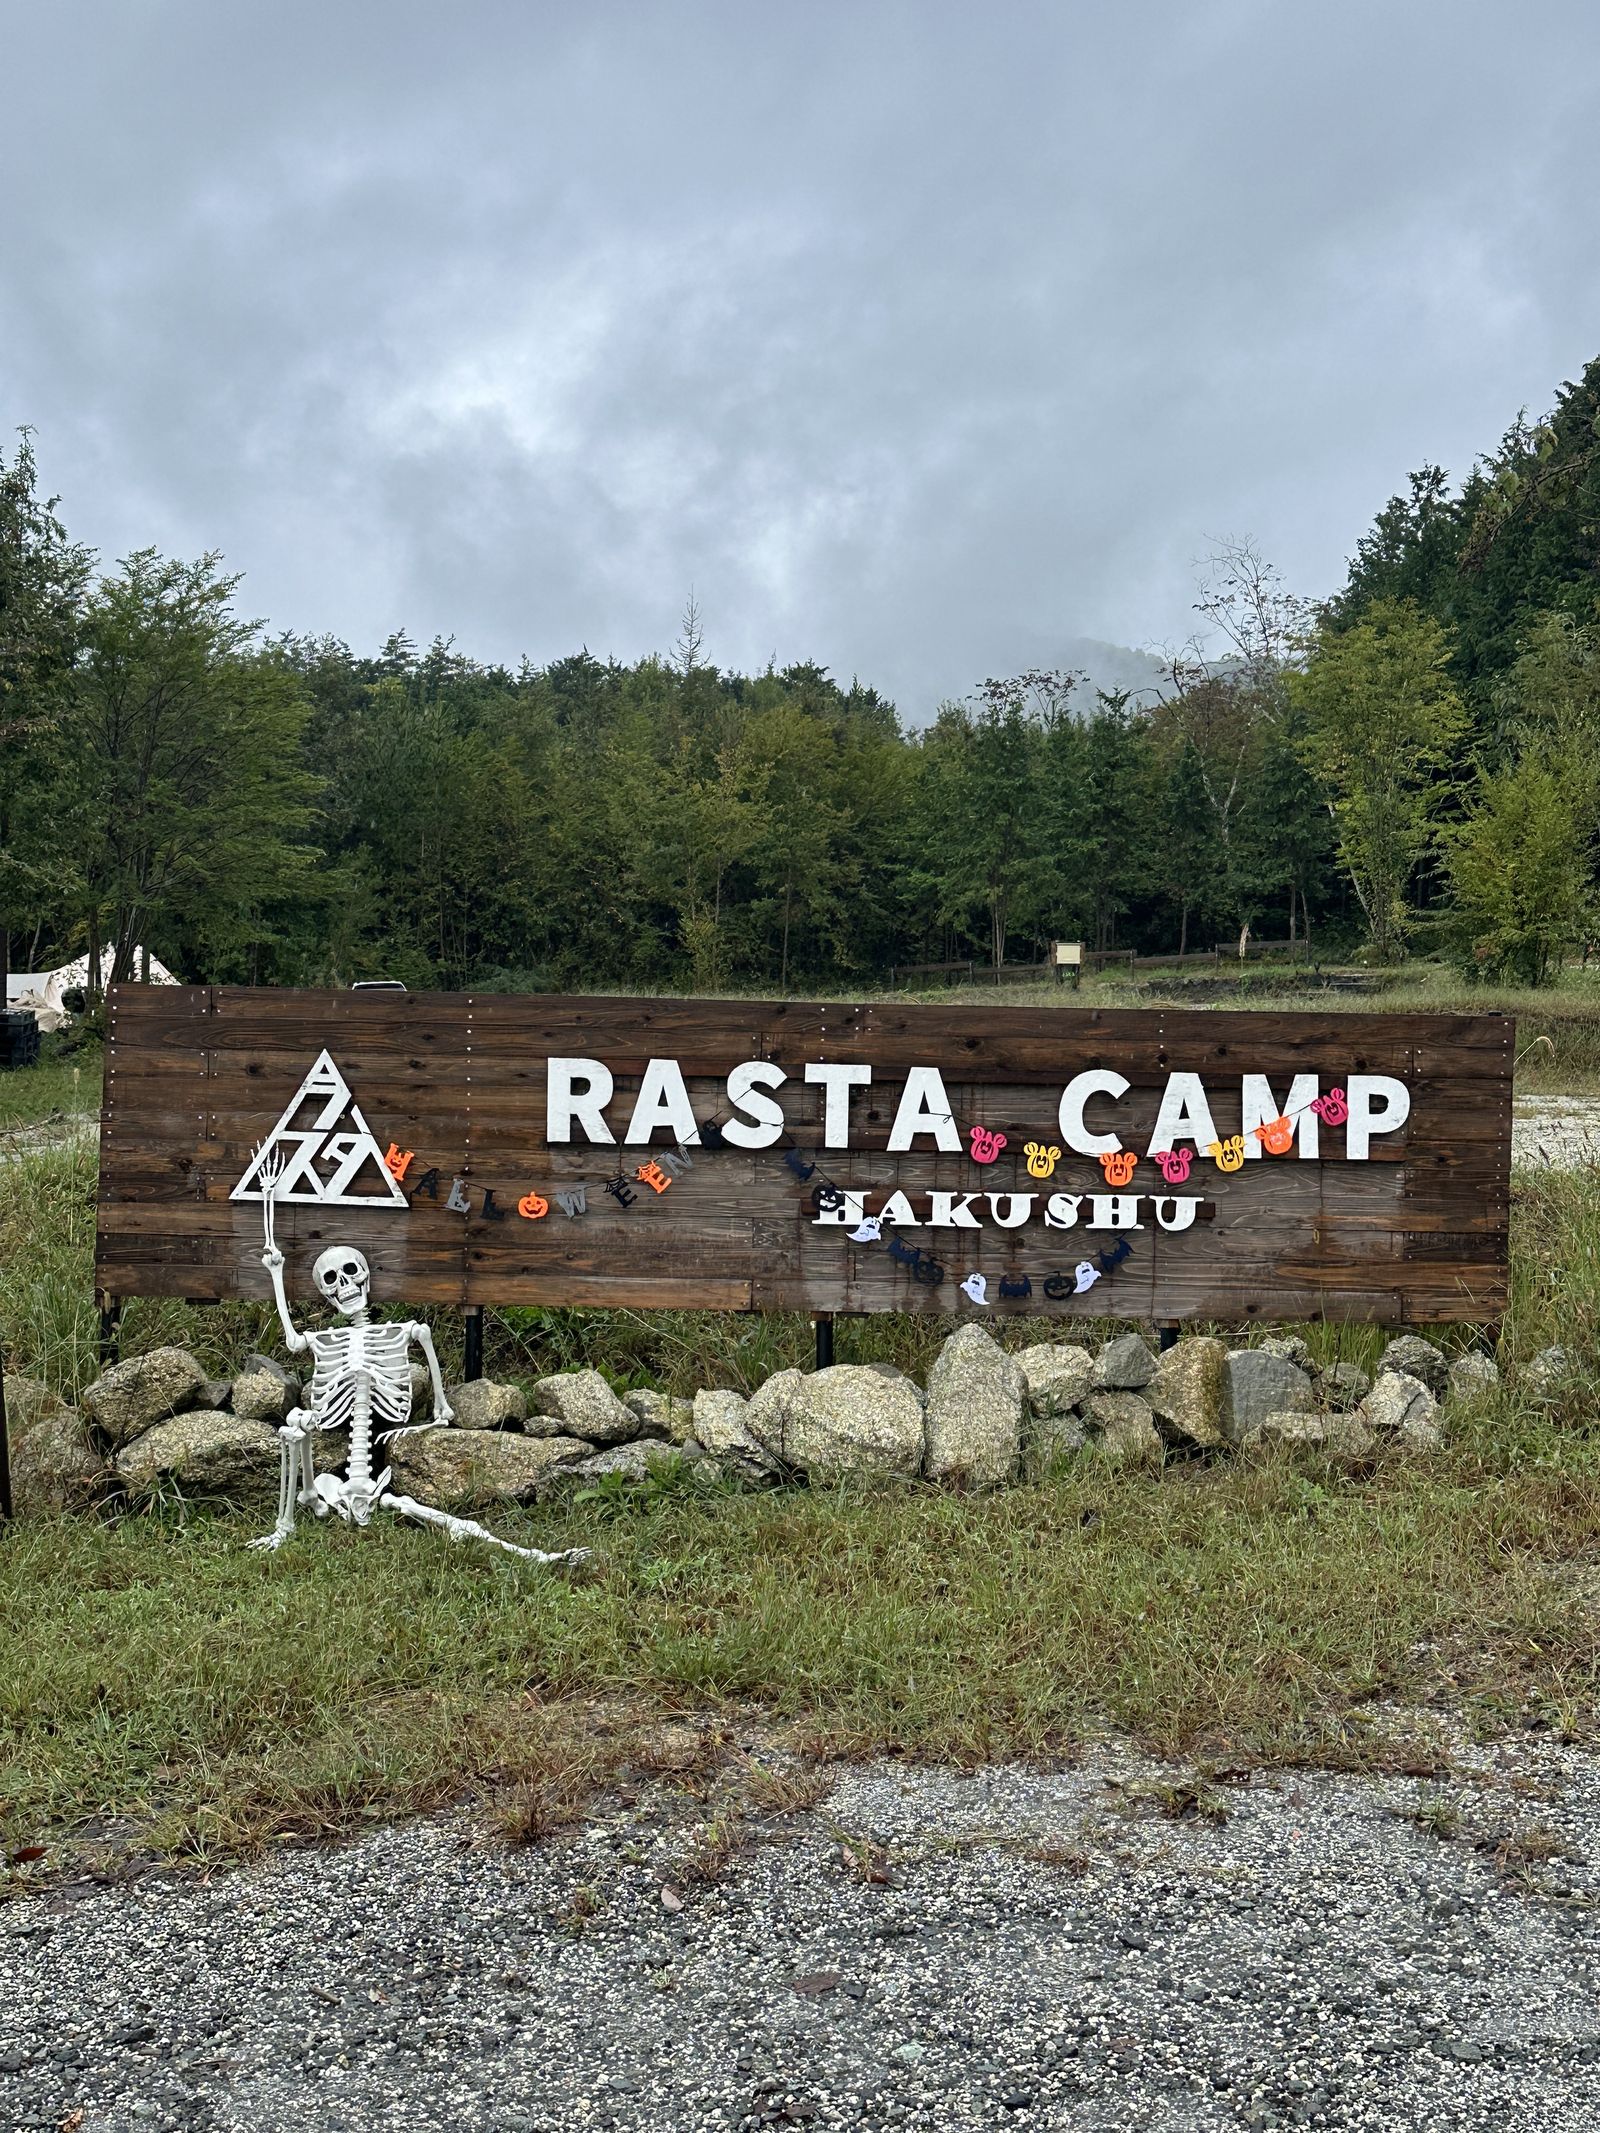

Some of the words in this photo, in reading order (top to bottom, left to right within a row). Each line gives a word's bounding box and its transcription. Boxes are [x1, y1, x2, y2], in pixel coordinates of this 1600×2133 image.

[547, 1057, 963, 1152] RASTA
[1058, 1069, 1411, 1160] CAMP
[811, 1189, 1205, 1232] HAKUSHU
